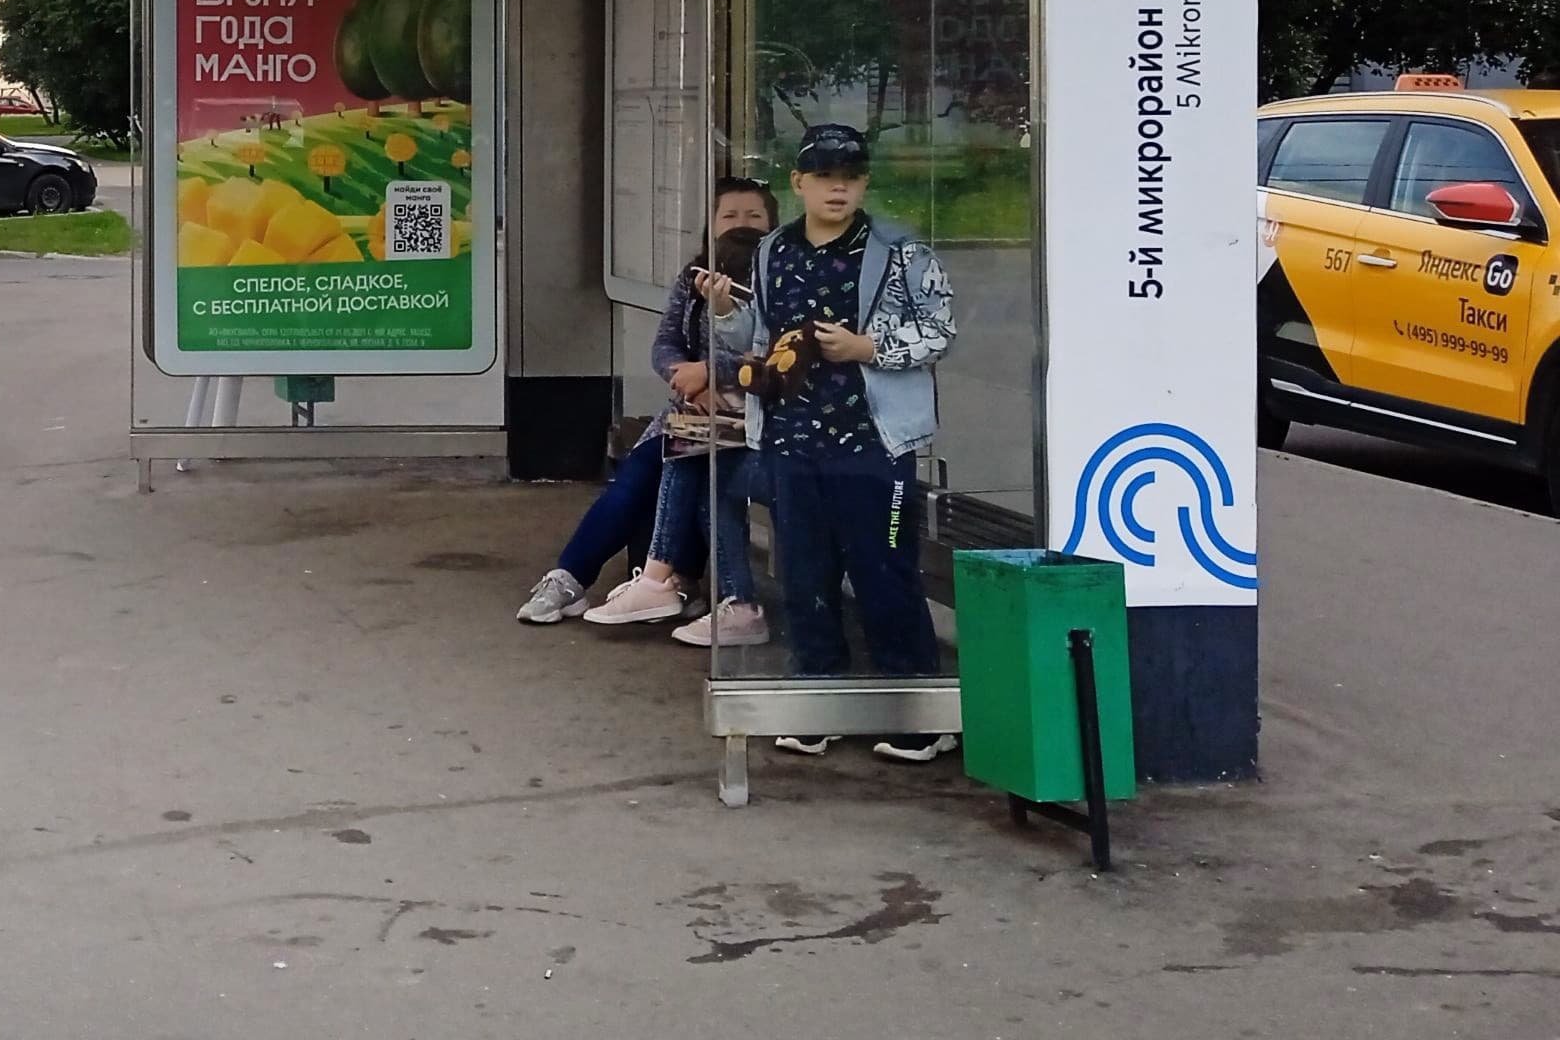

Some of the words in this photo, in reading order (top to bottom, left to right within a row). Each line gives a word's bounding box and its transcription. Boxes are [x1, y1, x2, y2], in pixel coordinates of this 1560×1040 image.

[195, 53, 317, 83] МАНГО
[1176, 94, 1201, 108] 5
[1128, 8, 1172, 235] микрорайон
[1128, 247, 1164, 299] 5-й
[1323, 247, 1353, 273] 567
[1417, 249, 1482, 282] Яндекс
[1486, 260, 1513, 289] Go
[233, 276, 311, 294] СПЕЛОЕ,
[315, 273, 408, 292] СЛАДКОЕ,
[193, 301, 206, 315] С
[211, 294, 332, 316] БЕСПЛАТНОЙ
[336, 289, 449, 314] ДОСТАВКОЙ
[1458, 297, 1508, 333] Такси
[1406, 322, 1438, 347] (495)
[1441, 332, 1509, 364] 999-99-99
[891, 480, 905, 510] FUTURE
[890, 510, 900, 525] THE
